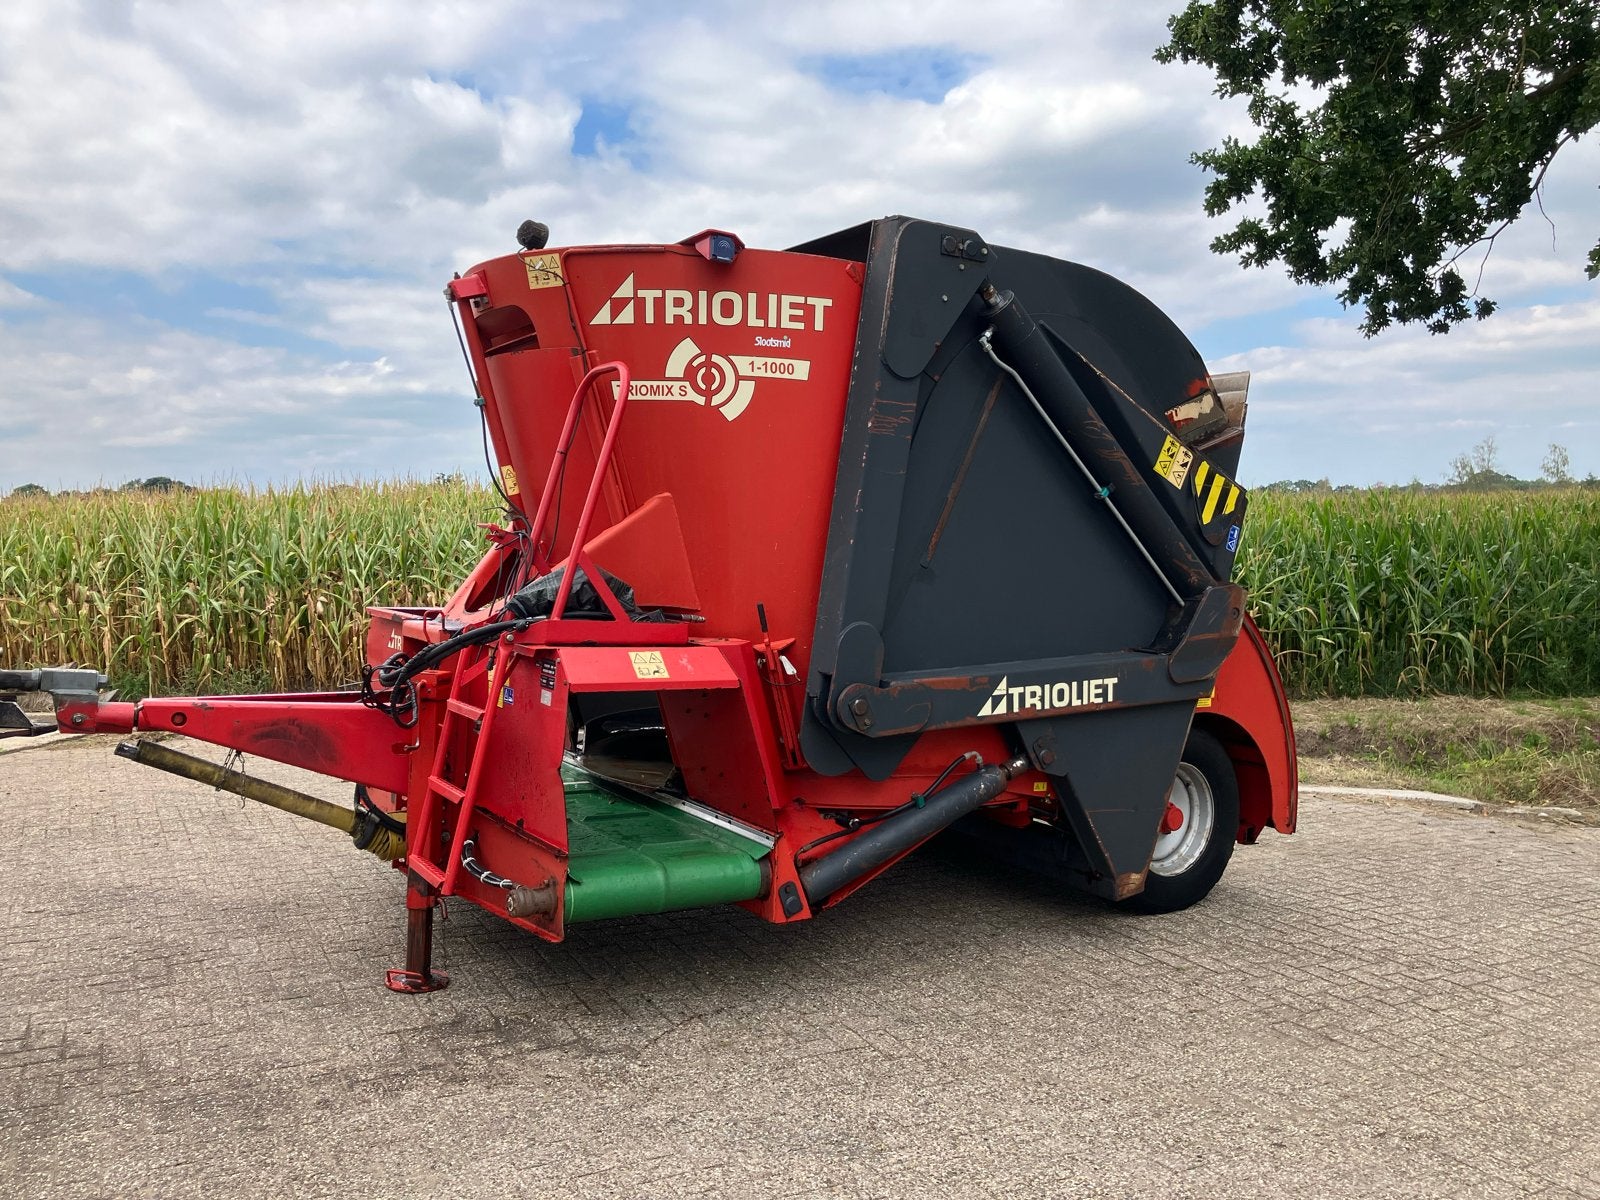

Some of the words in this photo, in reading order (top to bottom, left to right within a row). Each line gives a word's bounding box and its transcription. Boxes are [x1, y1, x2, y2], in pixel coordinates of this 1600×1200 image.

[637, 289, 833, 331] TRIOLIET
[754, 335, 791, 348] Slootsmid
[748, 360, 795, 376] 1-1000
[678, 384, 688, 397] S
[1008, 677, 1118, 713] TRIOLIET
